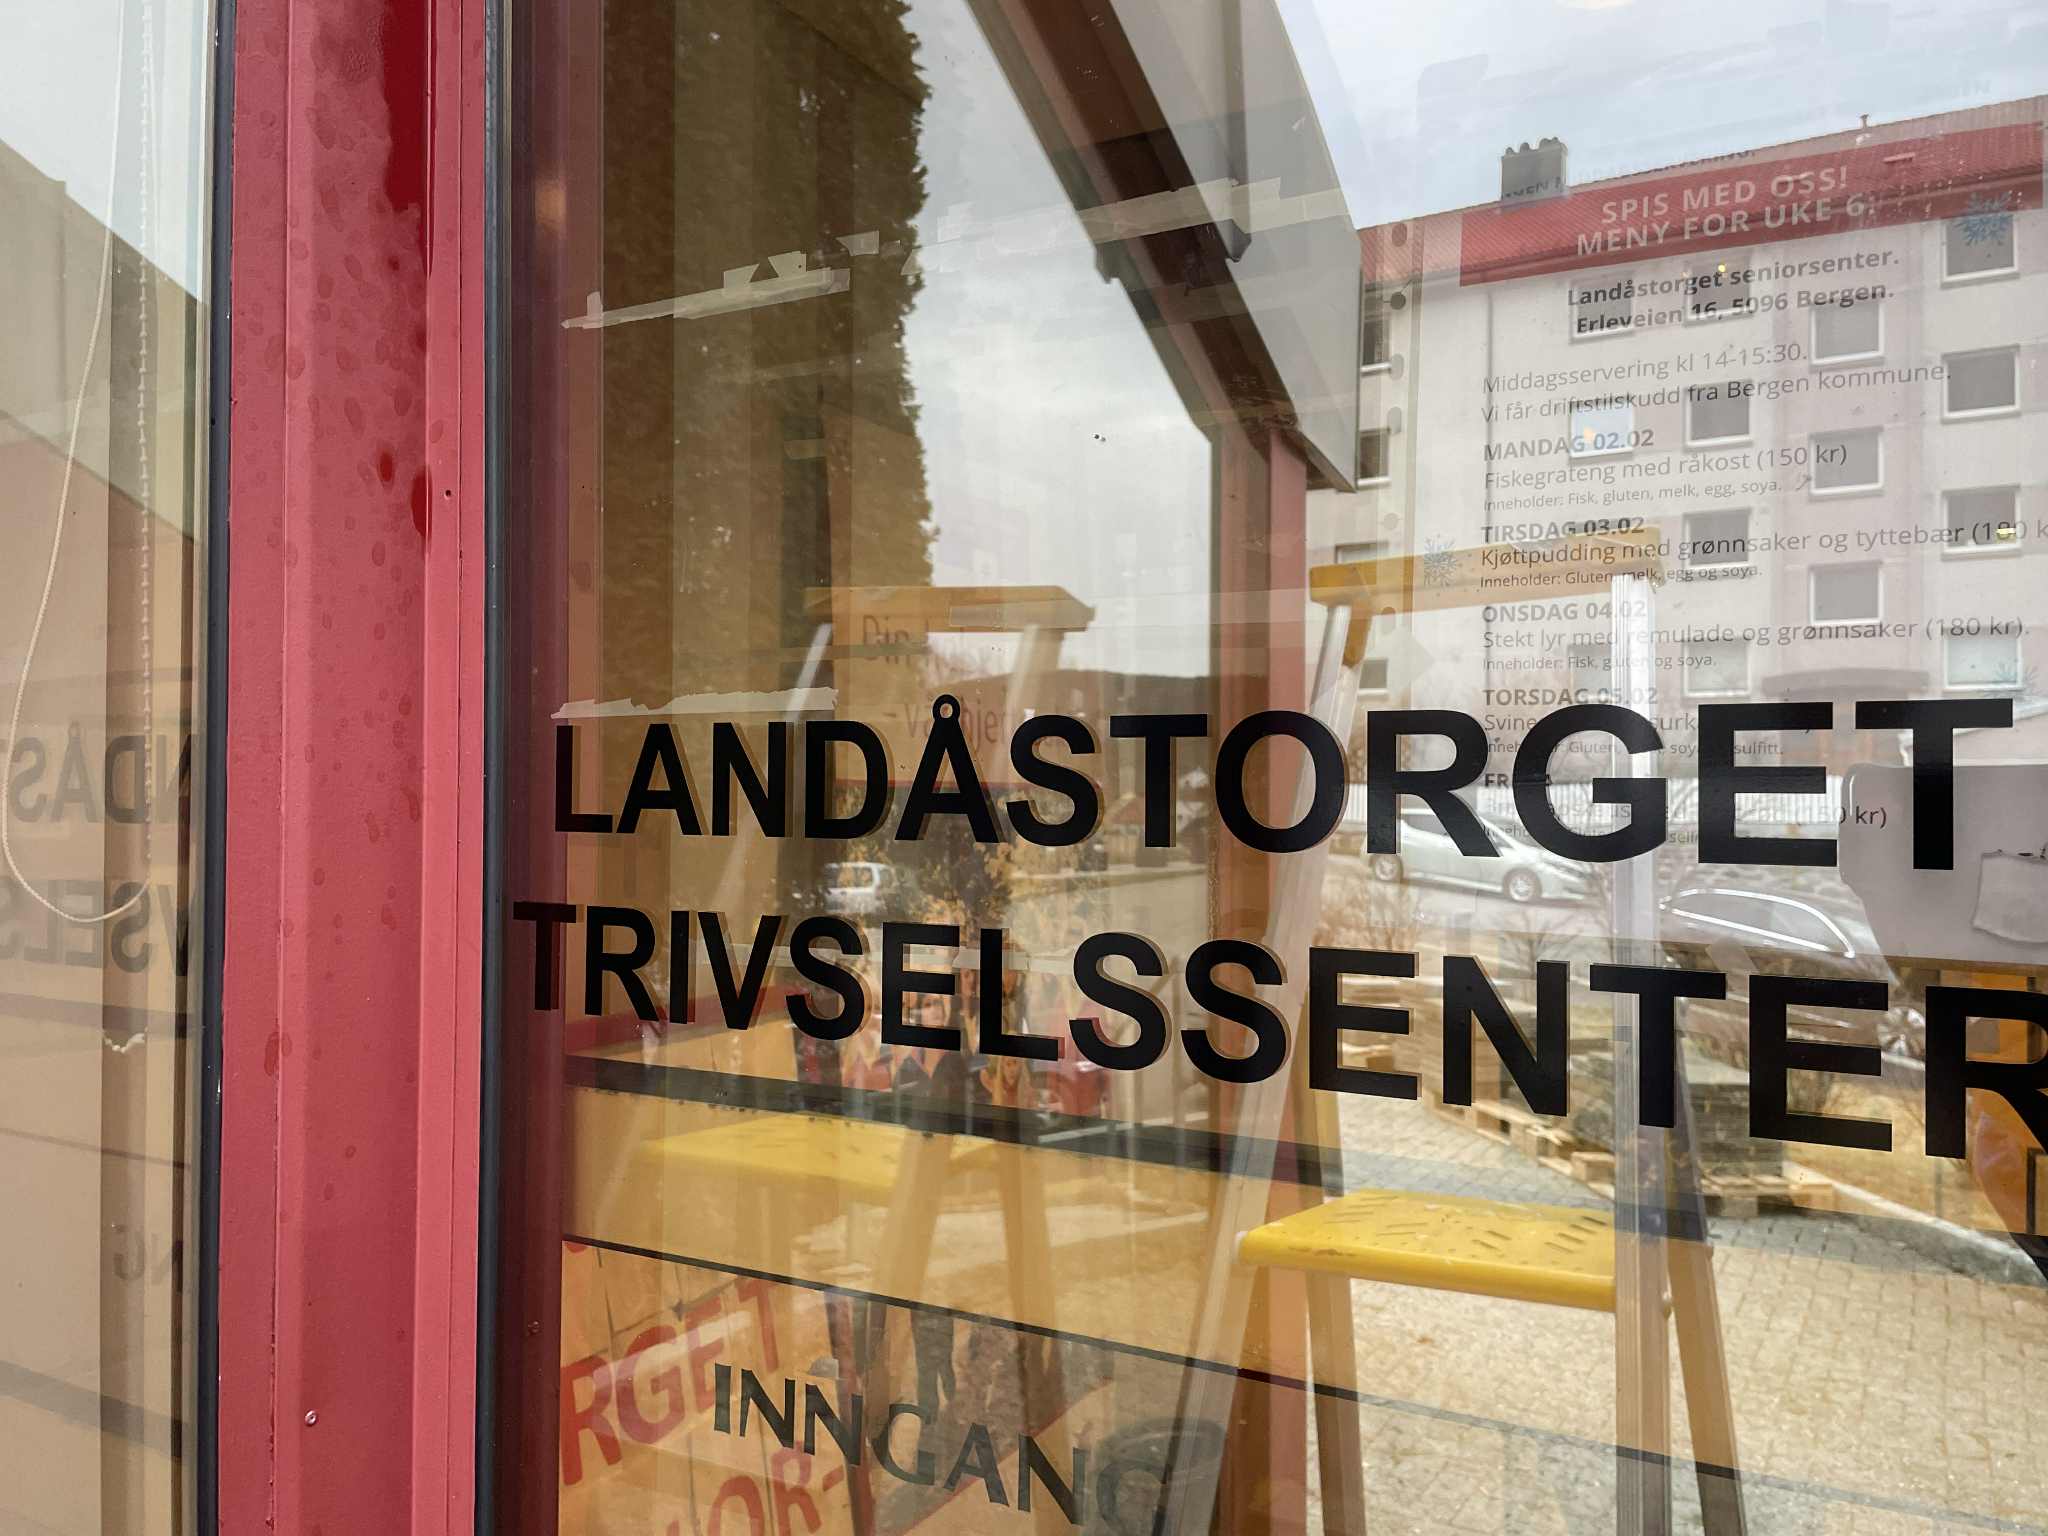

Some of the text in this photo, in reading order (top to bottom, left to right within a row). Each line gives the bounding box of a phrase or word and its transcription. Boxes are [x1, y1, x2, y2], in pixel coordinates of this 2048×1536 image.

[1602, 166, 1848, 224] SPIS MED OSS!
[1578, 222, 1669, 256] MENY
[1684, 209, 1749, 241] FOR
[1764, 199, 1832, 230] UKE
[1568, 250, 1900, 306] Landåstorget seniorsenter.
[1577, 308, 1683, 334] Erleveien
[1733, 293, 1788, 317] 5096
[1797, 284, 1894, 307] Bergen.
[1482, 343, 1807, 393] Middagsservering kl 14-15:30.
[1482, 365, 1951, 422] Vi får driftstilskudd fra Bergen kommune.
[1484, 429, 1654, 461] MANDAG 02.02
[1485, 445, 1847, 490] Fiskegrateng med råkost (150 kr)
[1602, 488, 1653, 506] gluten,
[1659, 484, 1699, 498] melk,
[1704, 483, 1735, 499] egg,
[1741, 479, 1782, 493] soya.
[1481, 517, 1645, 543] TIRSDAG 03.02
[1481, 543, 1616, 570] Kjøttpudding
[1622, 539, 1670, 558] med
[1678, 532, 1811, 560] grønnsaker
[1819, 534, 1848, 553] og
[1856, 524, 1964, 552] tyttebær
[1481, 573, 1560, 588] Inneholder:
[1667, 568, 1693, 582] egg
[1699, 567, 1717, 580] og
[1722, 564, 1762, 579] soya.
[1482, 603, 1578, 623] ONSDAG
[1483, 630, 1535, 649] Stekt
[1541, 629, 1565, 652] lyr
[1628, 623, 1734, 645] remulade
[1743, 628, 1770, 646] og
[1777, 622, 1918, 646] grønnsaker
[1926, 617, 1981, 640] (180
[1990, 616, 2030, 639] kr).
[1654, 656, 1672, 669] og
[1483, 688, 1589, 706] TORSDAG
[555, 694, 2013, 871] LANDÅSTORGET
[1856, 806, 1887, 829] kr)
[514, 903, 2048, 1160] TRIVSELSSENTER
